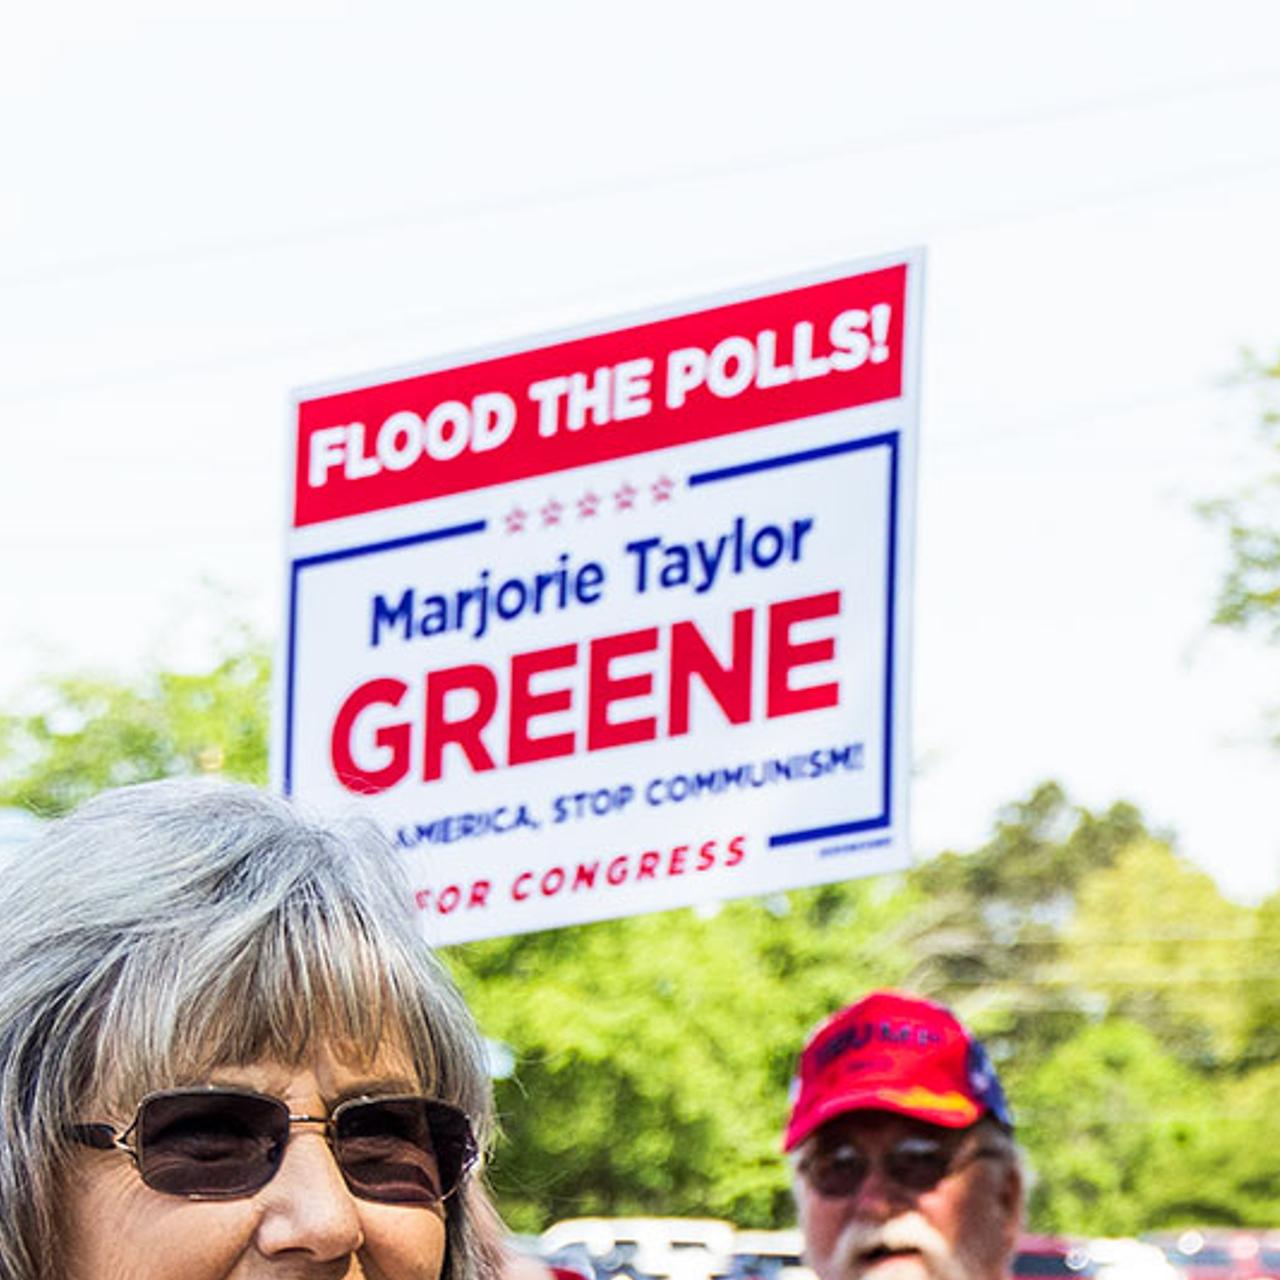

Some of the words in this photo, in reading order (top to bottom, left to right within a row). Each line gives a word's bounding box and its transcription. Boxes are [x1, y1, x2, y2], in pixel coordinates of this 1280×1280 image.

[309, 392, 517, 487] FLOOD
[528, 358, 654, 437] THE
[666, 303, 891, 409] POLLS!
[369, 553, 607, 649] Marjorie
[623, 517, 815, 596] Taylor
[329, 590, 841, 797] GREENE
[553, 784, 635, 824] STOP
[645, 742, 866, 807] COMMUNISM!
[511, 836, 747, 902] CONGRESS
